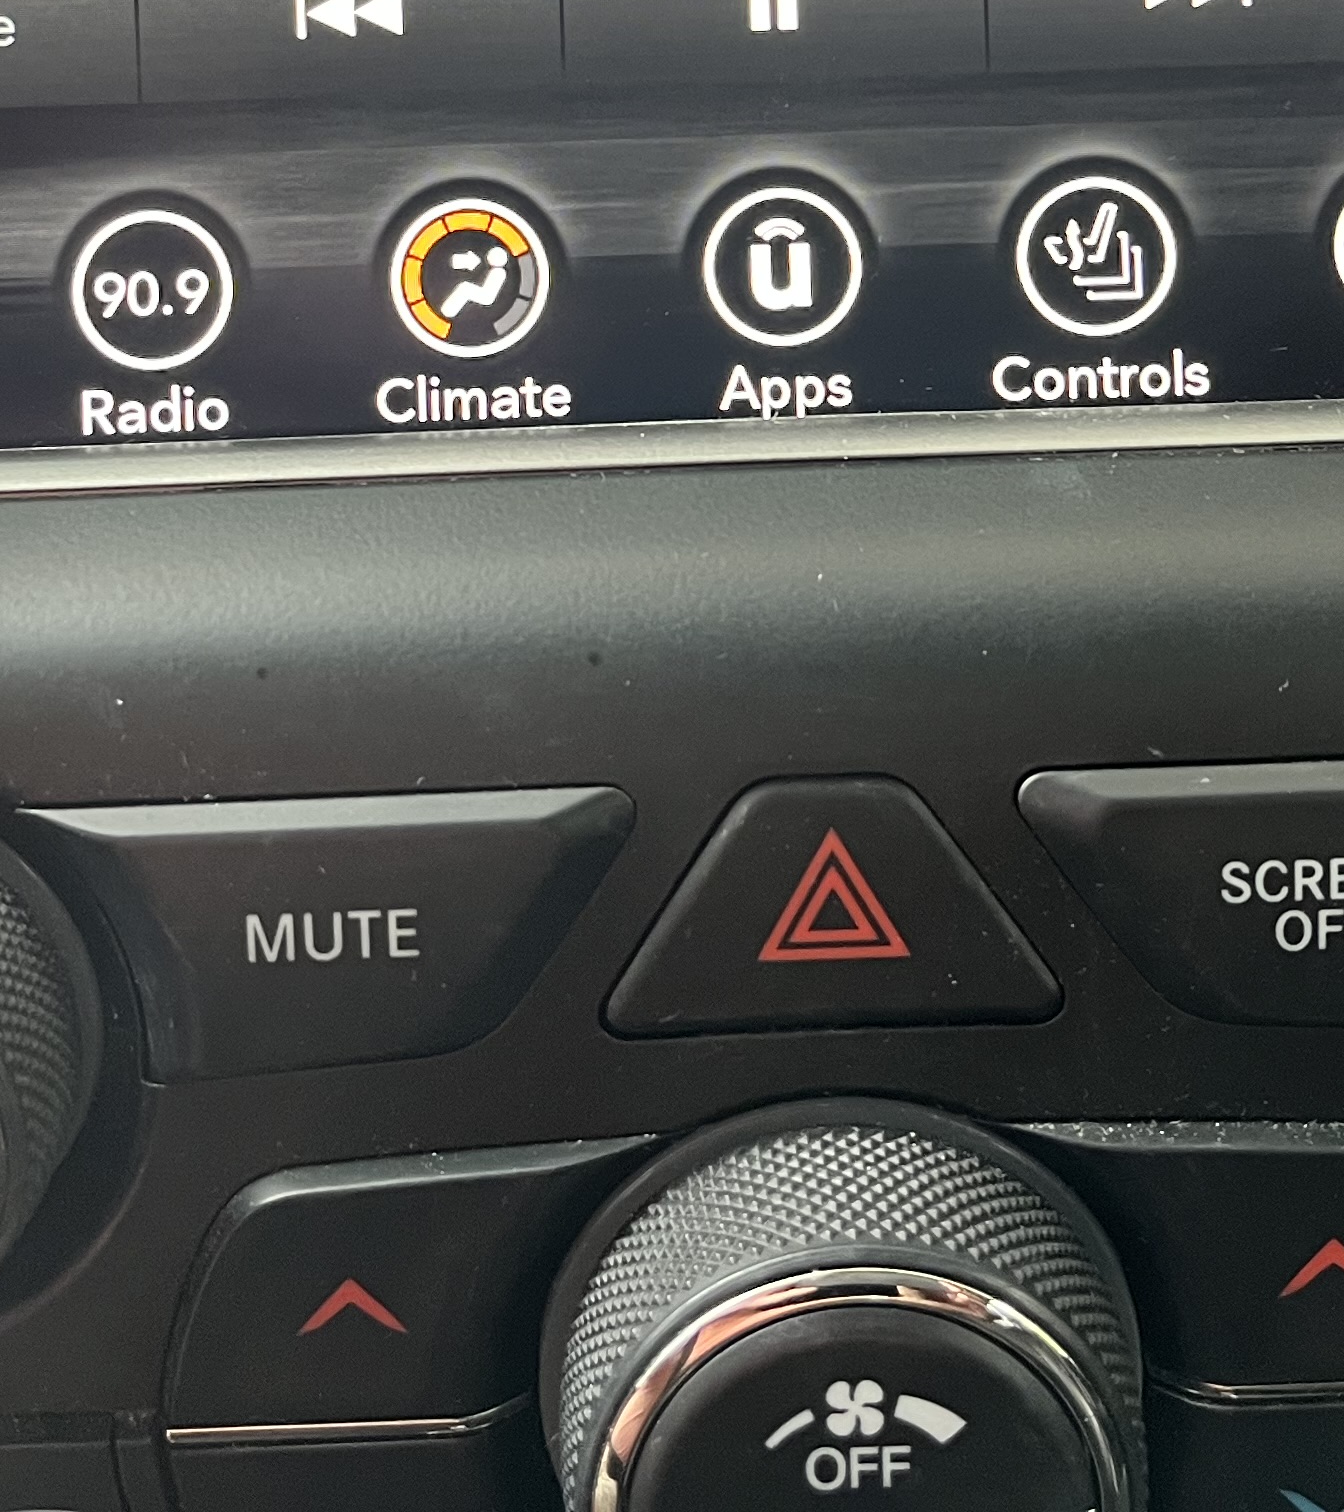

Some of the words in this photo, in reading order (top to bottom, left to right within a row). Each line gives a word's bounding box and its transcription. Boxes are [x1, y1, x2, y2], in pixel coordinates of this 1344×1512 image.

[93, 268, 210, 319] 90.9
[375, 374, 572, 424] Climate
[719, 365, 852, 420] Apps
[993, 348, 1210, 403] Controls
[80, 383, 230, 436] Radio
[245, 908, 420, 963] MUTE
[805, 1445, 912, 1491] OFF
